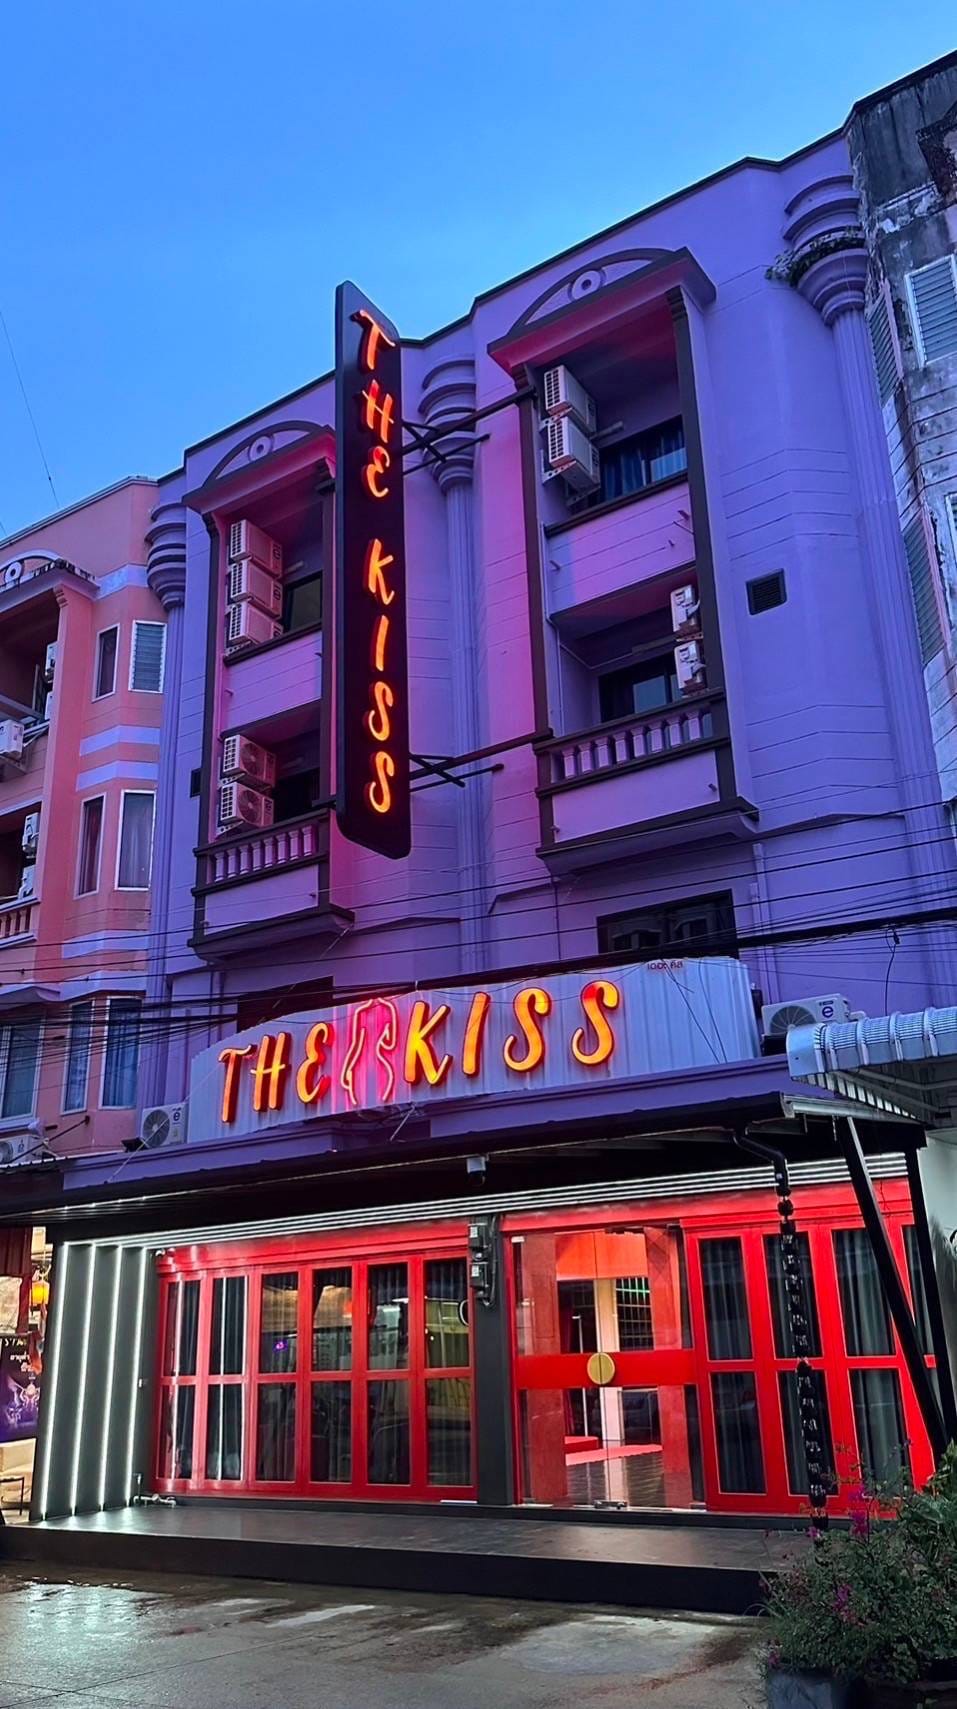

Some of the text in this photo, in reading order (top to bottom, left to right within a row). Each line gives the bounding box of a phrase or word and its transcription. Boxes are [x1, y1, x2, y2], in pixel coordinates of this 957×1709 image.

[353, 309, 396, 814] THE KISS
[218, 980, 620, 1124] THE KISS
